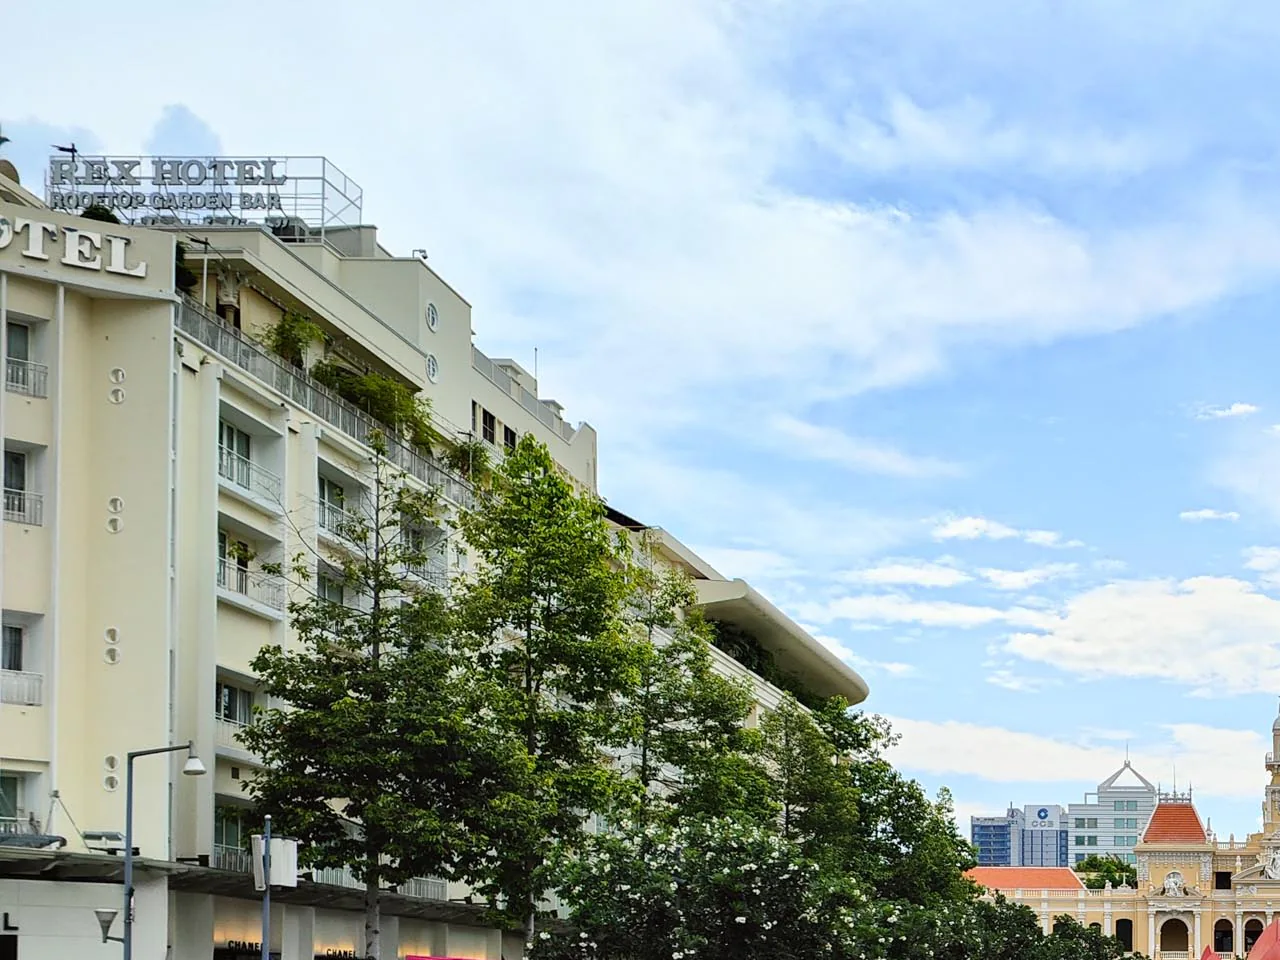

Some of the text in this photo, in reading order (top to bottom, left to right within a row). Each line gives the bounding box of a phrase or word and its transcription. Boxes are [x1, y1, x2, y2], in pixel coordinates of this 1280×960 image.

[50, 160, 287, 185] REX HOTEL
[50, 191, 281, 209] ROOFTOP GARDEN BAR
[326, 948, 357, 959] CHANEL
